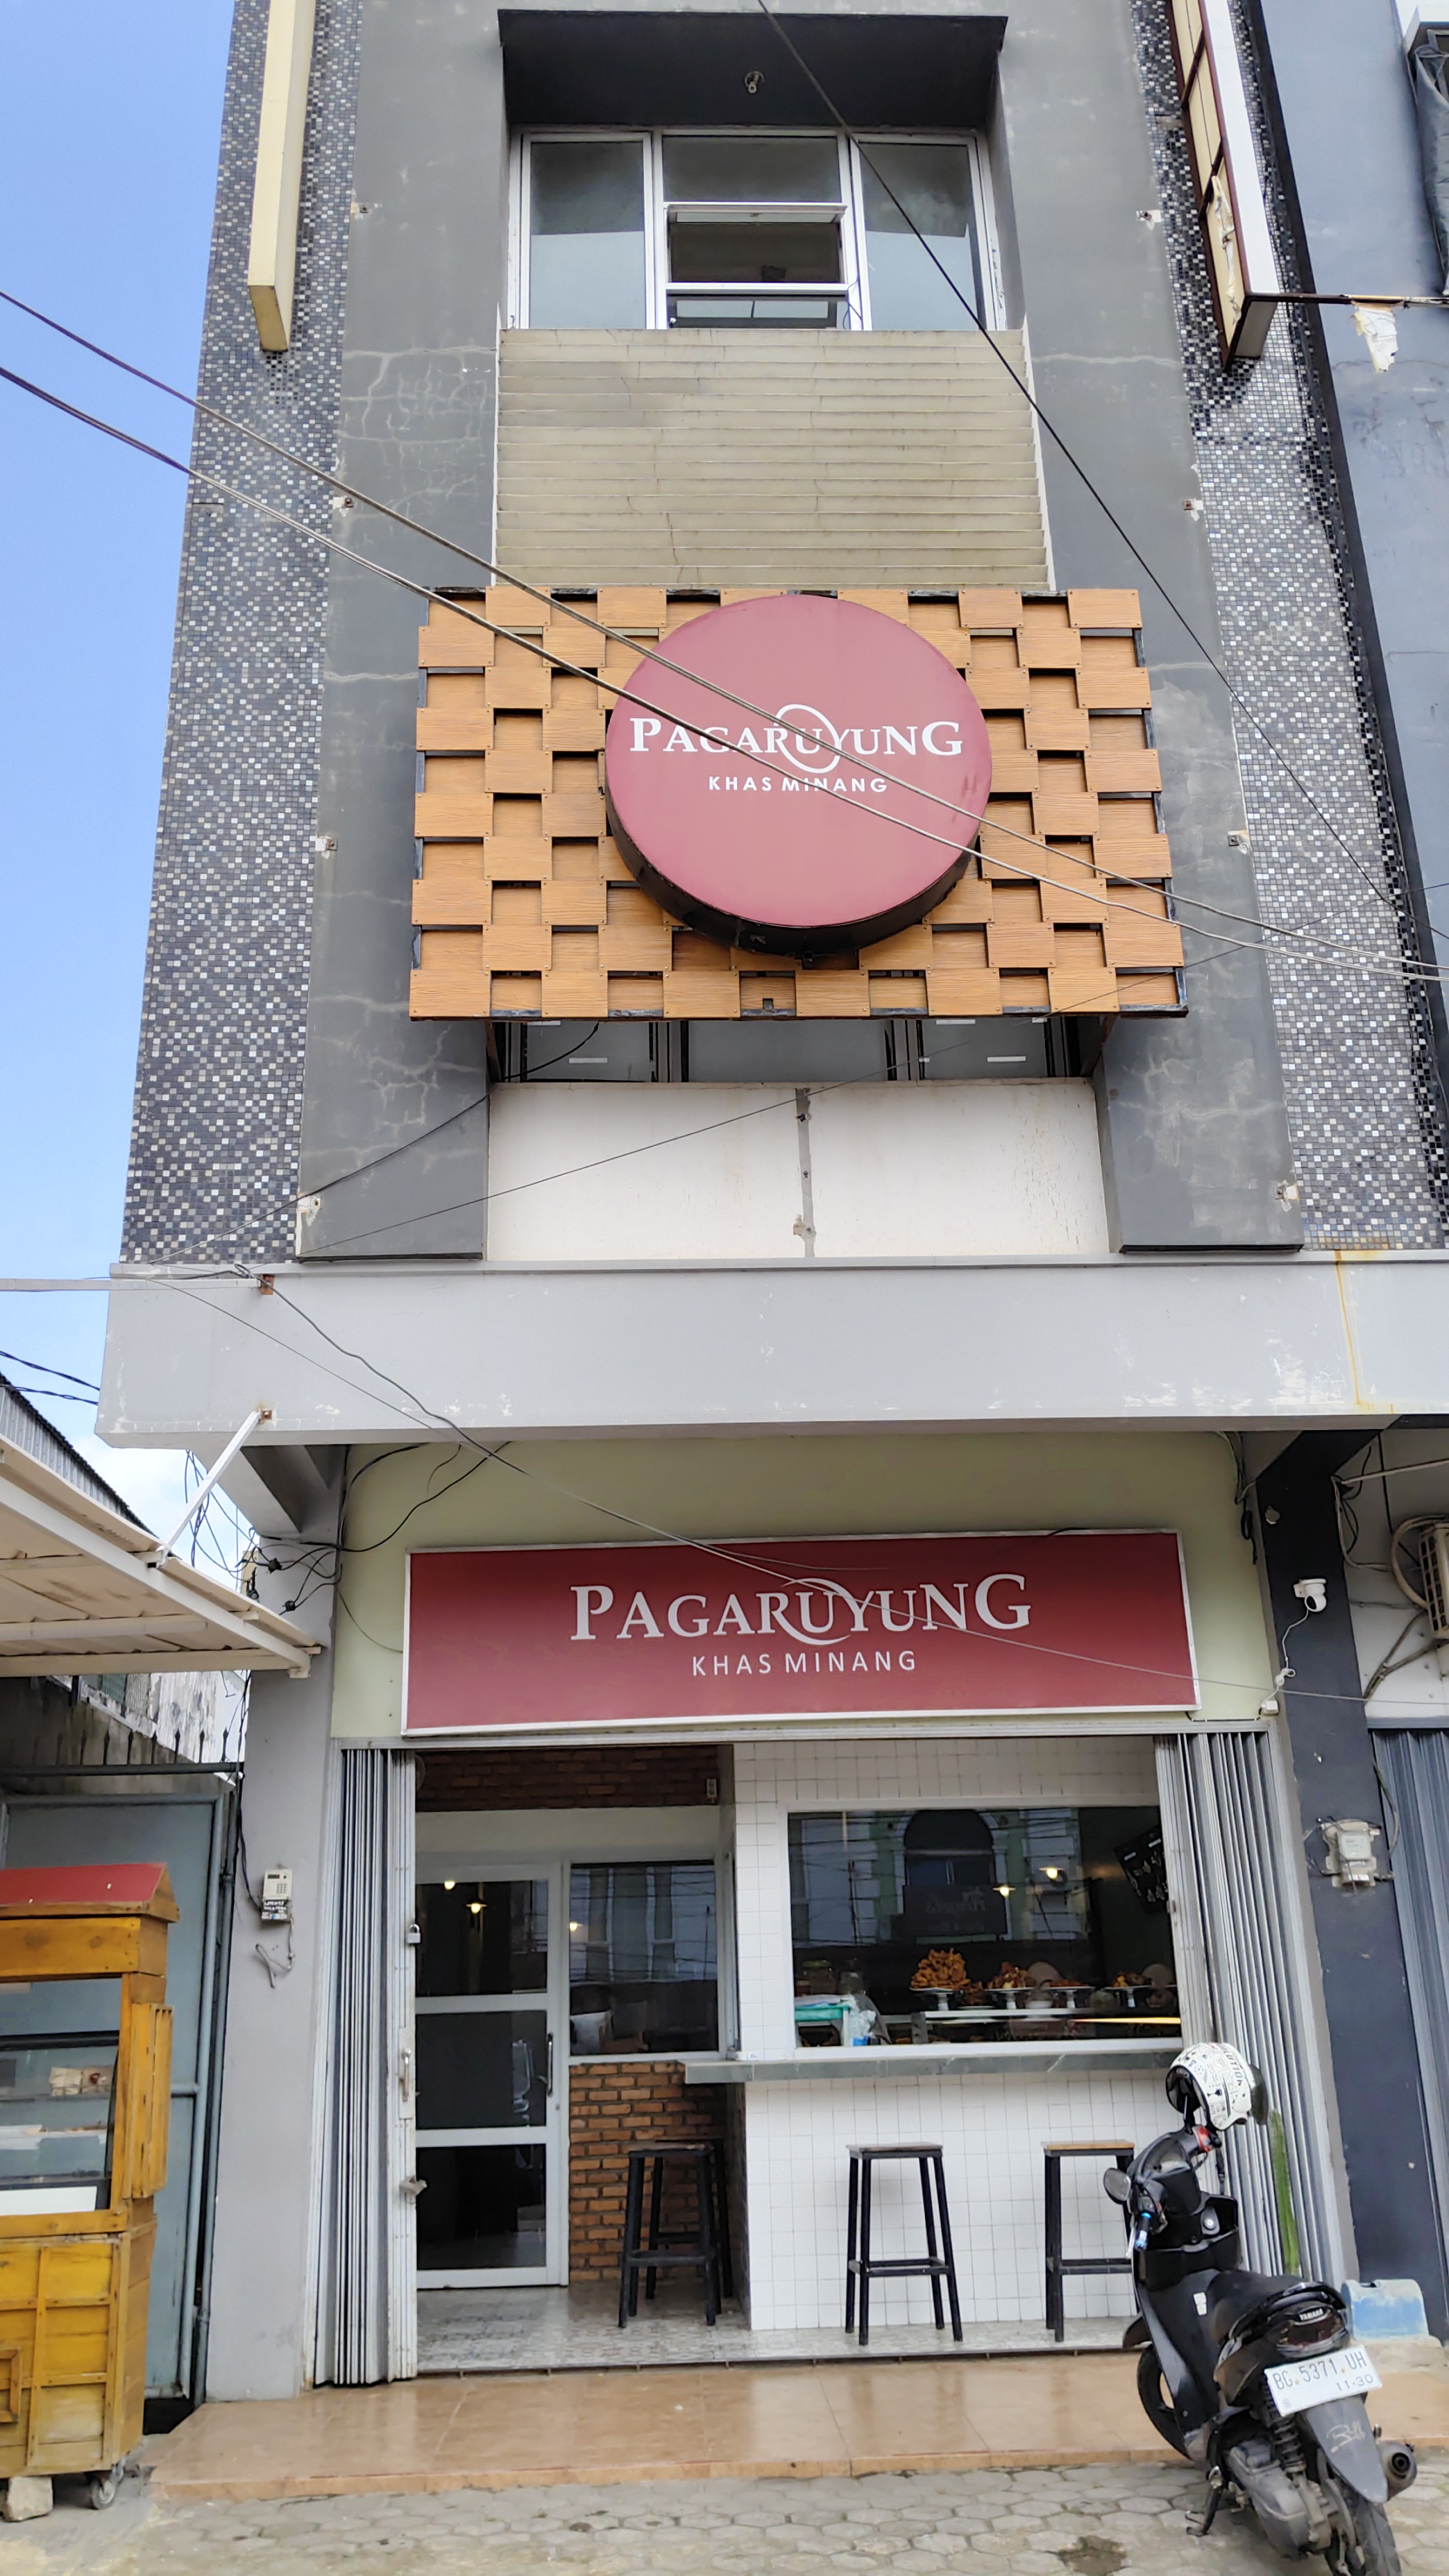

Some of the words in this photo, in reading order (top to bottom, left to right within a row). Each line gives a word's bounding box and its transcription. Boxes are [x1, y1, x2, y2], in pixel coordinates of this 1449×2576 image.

[629, 704, 963, 773] PAGARUYUNG
[709, 776, 772, 791] KHAS
[781, 777, 888, 793] MINANG
[570, 1574, 1031, 1645] PAGARUYUNG
[693, 1654, 772, 1676] KHAS
[786, 1650, 915, 1673] MINANG
[1299, 2308, 1323, 2321] YAMAHA
[1273, 2371, 1293, 2389] BG
[1299, 2359, 1338, 2382] 5371
[1345, 2351, 1366, 2370] UH
